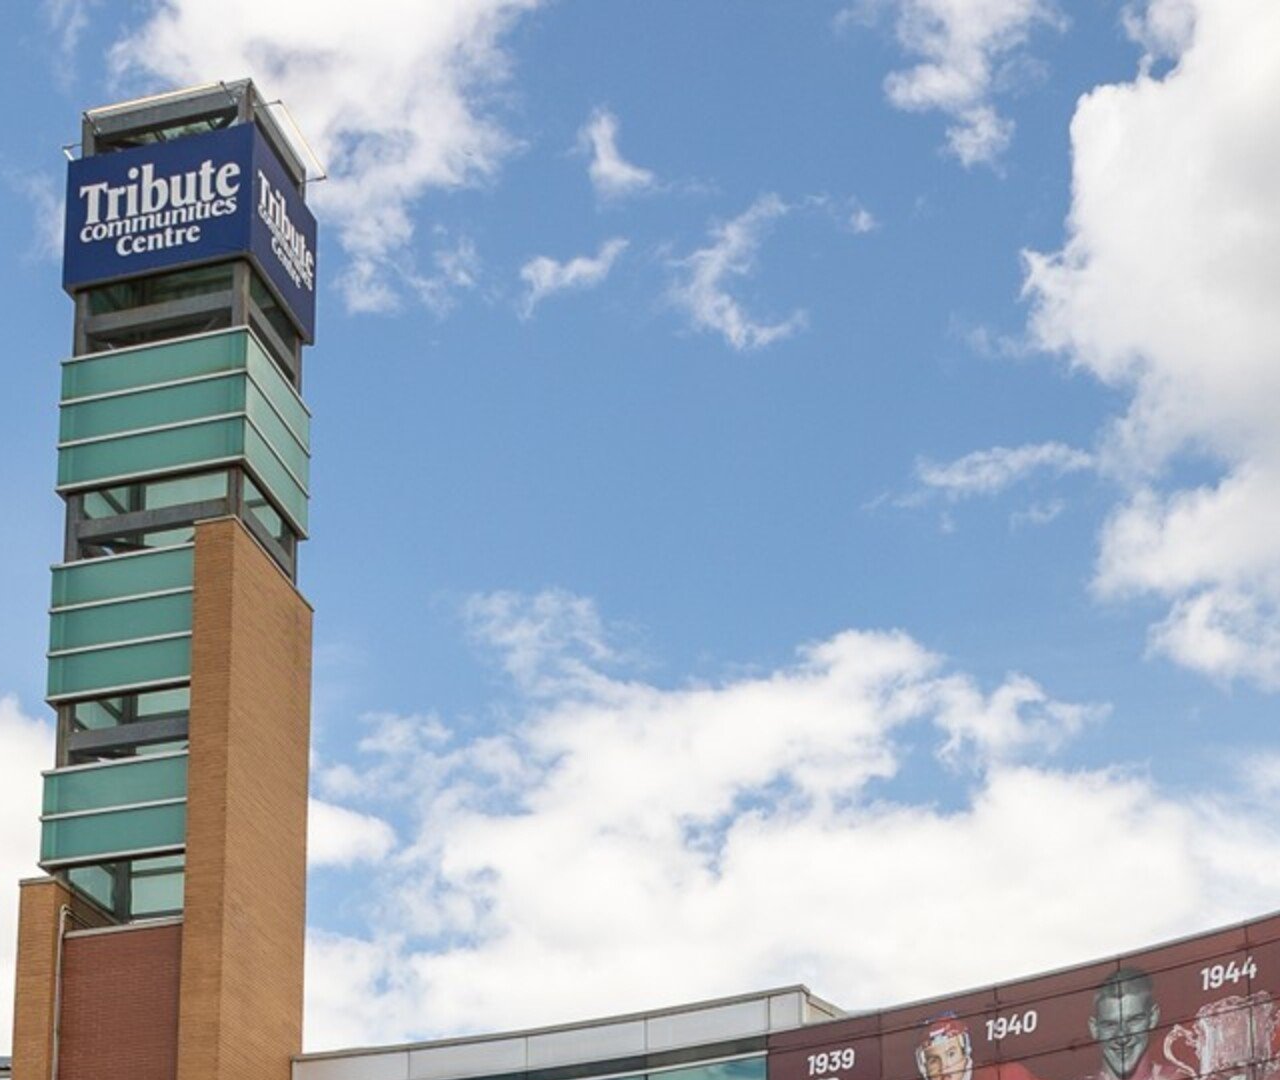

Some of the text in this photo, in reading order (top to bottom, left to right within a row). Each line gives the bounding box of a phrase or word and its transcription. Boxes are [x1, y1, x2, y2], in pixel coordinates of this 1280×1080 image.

[79, 158, 241, 225] Tribute
[79, 196, 238, 243] communities
[257, 168, 314, 278] Tribute
[115, 224, 201, 257] Centre
[1199, 956, 1258, 991] 1944
[985, 1011, 1037, 1041] 1940
[806, 1048, 856, 1076] 1939
